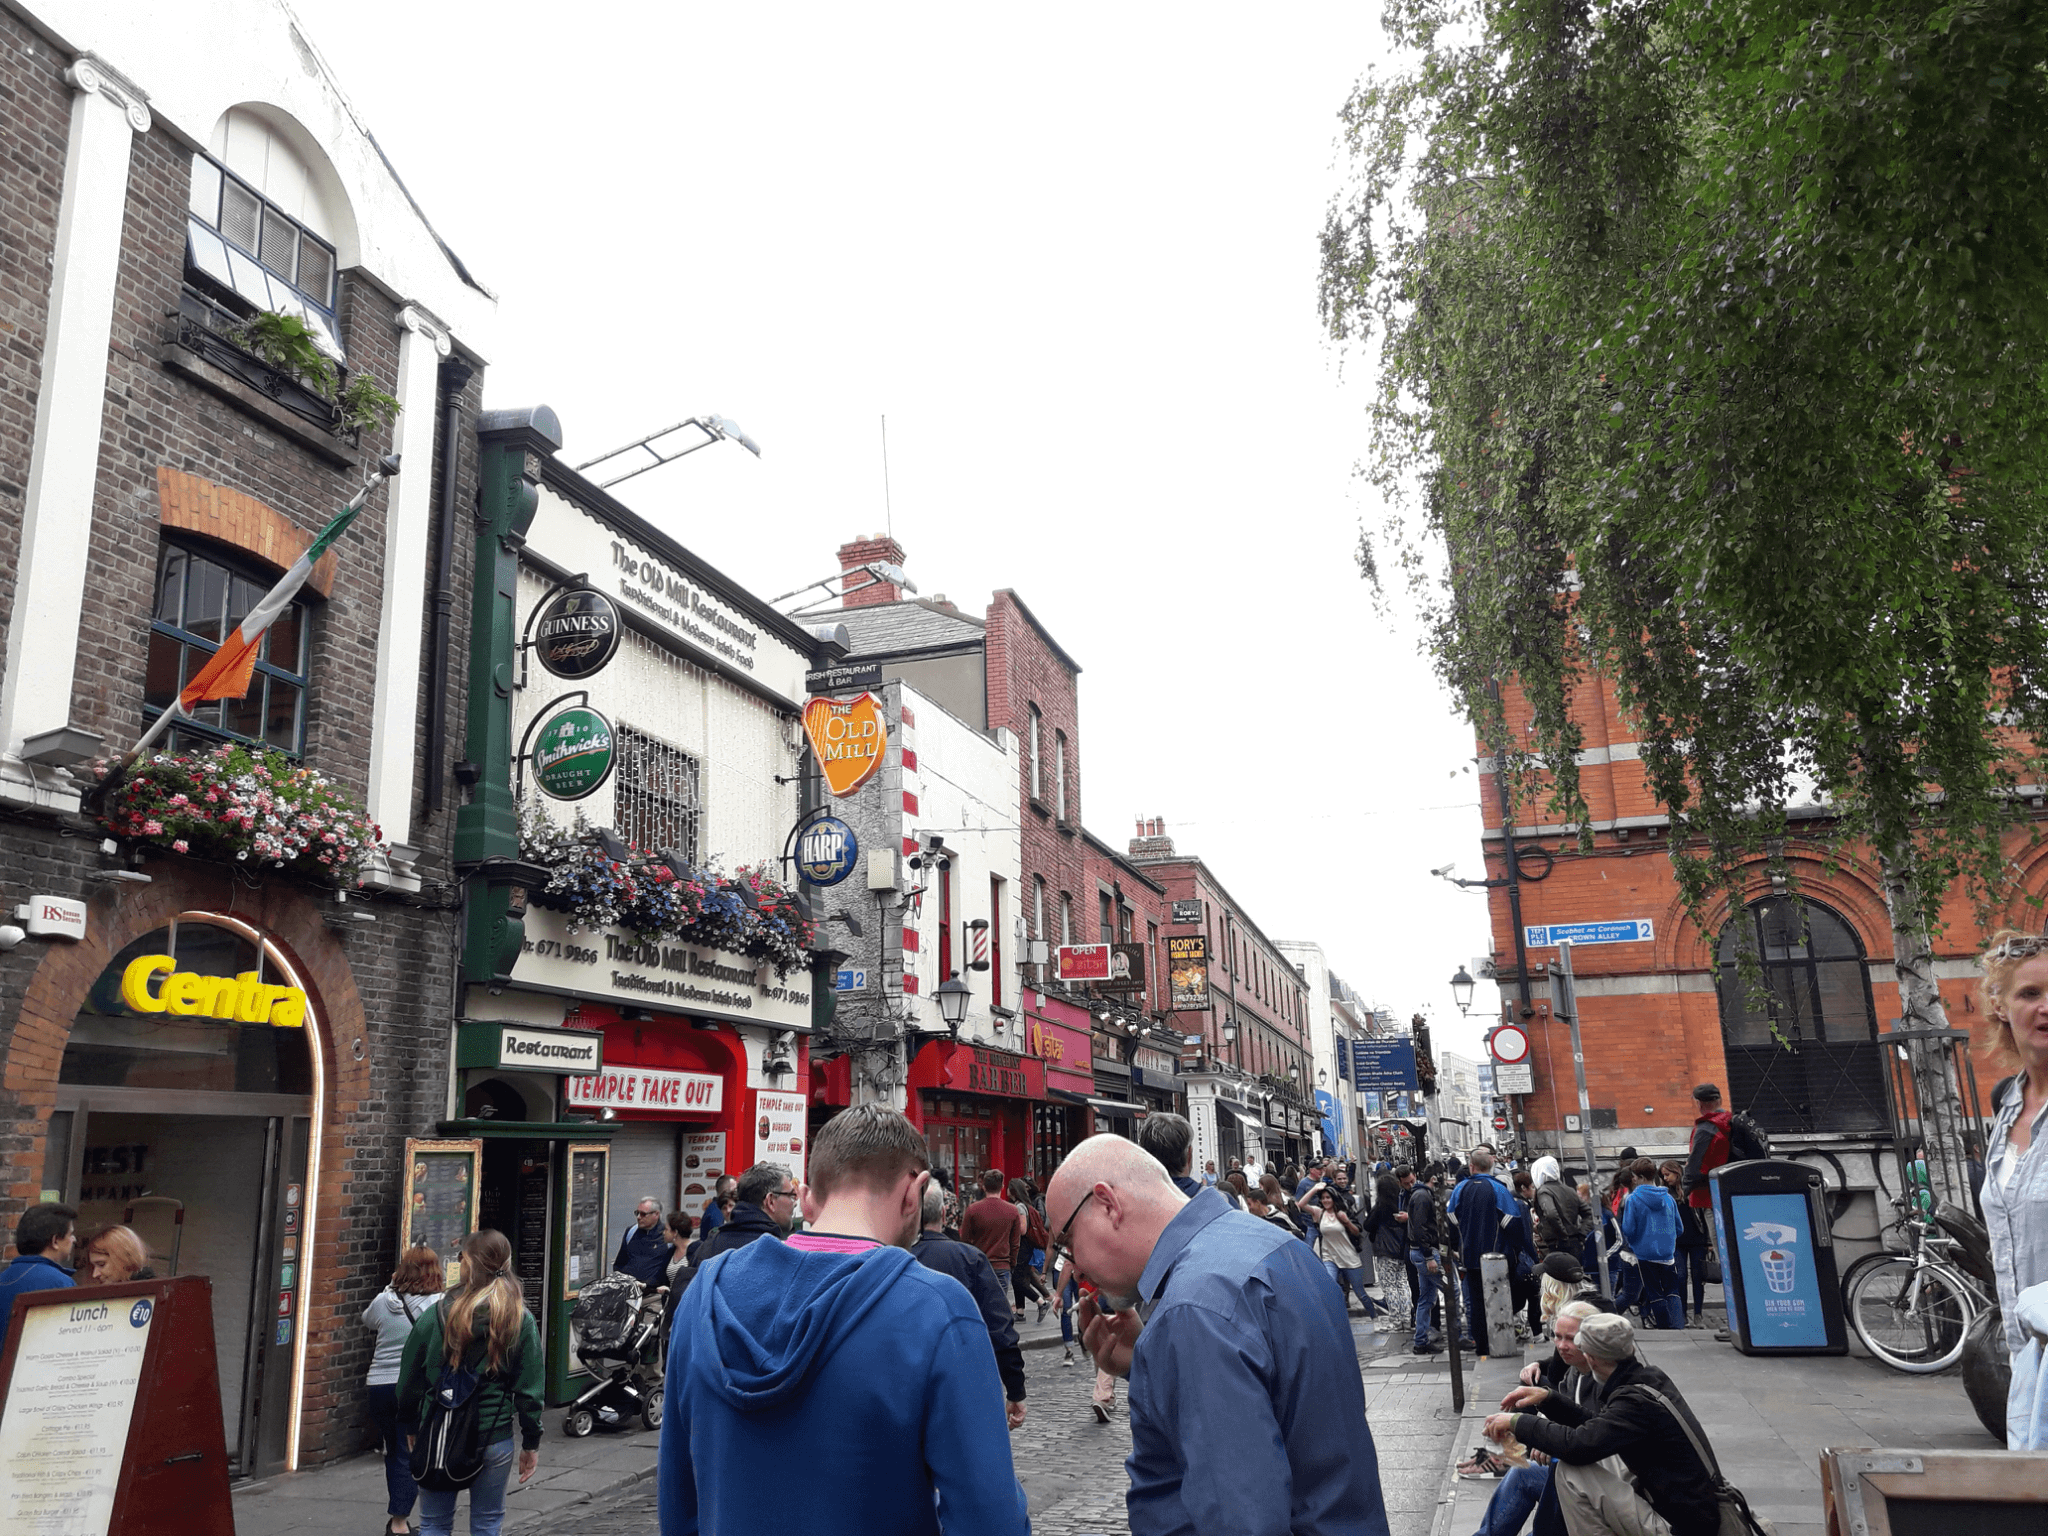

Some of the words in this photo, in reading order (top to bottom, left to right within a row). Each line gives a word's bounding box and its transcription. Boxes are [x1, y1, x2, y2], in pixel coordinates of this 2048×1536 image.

[610, 540, 638, 577] The
[665, 576, 690, 610] Mill
[690, 590, 757, 650] Restaurant
[541, 616, 609, 637] GUINNESS
[618, 577, 673, 623] Traditional
[673, 611, 680, 626] &
[681, 615, 715, 648] Modern
[716, 637, 736, 660] Irish
[736, 652, 754, 670] Food
[806, 672, 825, 681] IRISH
[826, 664, 877, 677] RESTAURANT
[828, 678, 835, 686] &
[836, 676, 852, 685] BAR
[831, 704, 852, 714] THE
[826, 716, 876, 740] OLD
[536, 733, 610, 777] Smithwick's
[825, 742, 877, 761] MILL
[546, 769, 592, 781] DRAUGHT
[556, 780, 584, 789] BEER
[803, 834, 842, 863] HARP
[1640, 923, 1651, 938] 2
[537, 939, 562, 957] 671
[565, 944, 599, 966] 9266
[1071, 946, 1097, 955] OPEN
[1170, 938, 1204, 951] RORY'S
[605, 934, 633, 961] The
[662, 946, 687, 973] Mill
[688, 952, 757, 987] Restaurant
[856, 972, 864, 987] 2
[121, 954, 307, 1028] Centra
[610, 970, 667, 995] Traditional
[675, 982, 711, 1002] Modern
[732, 992, 752, 1009] Food
[771, 987, 788, 1001] 671
[789, 988, 810, 1005] 9266
[505, 1036, 593, 1060] Restaurant
[973, 1048, 988, 1064] THE
[969, 1063, 1028, 1096] BARBER
[572, 1076, 636, 1101] TEMPLE
[641, 1077, 681, 1104] TAKE
[685, 1080, 714, 1106] OUT
[759, 1098, 782, 1111] TEMPLE
[782, 1102, 794, 1112] TAKE
[795, 1103, 804, 1112] OUT
[772, 1122, 792, 1132] BURGERS
[687, 1135, 720, 1143] TEMPLE
[767, 1142, 776, 1152] HOT
[776, 1142, 788, 1152] DOGS
[69, 1303, 108, 1322] Lunch
[132, 1307, 150, 1322] €10
[58, 1326, 82, 1335] Served
[96, 1324, 114, 1333] 6pm
